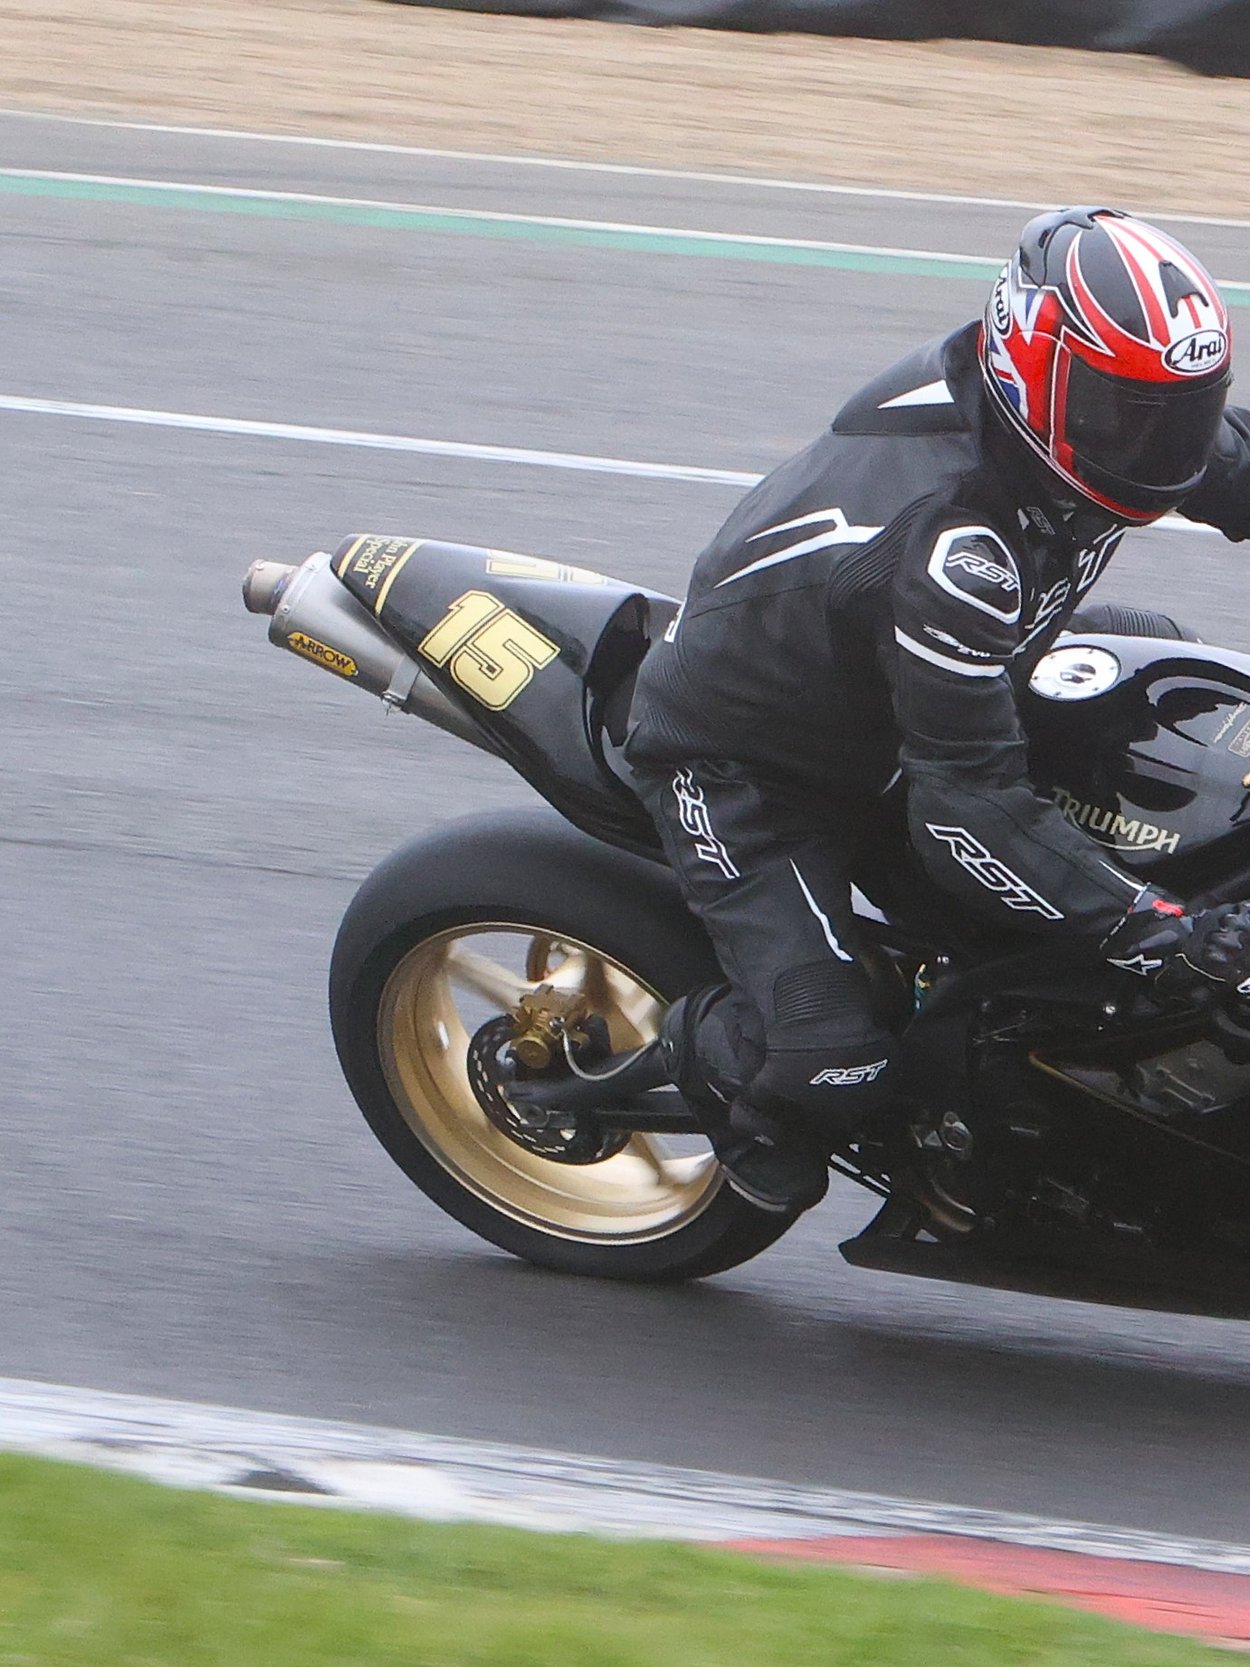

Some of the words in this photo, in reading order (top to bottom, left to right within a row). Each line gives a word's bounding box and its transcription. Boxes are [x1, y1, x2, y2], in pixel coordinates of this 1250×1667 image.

[1171, 332, 1222, 364] Arai
[945, 551, 1020, 592] RST
[294, 635, 351, 668] ARROW
[417, 588, 561, 711] 15
[672, 766, 741, 880] RST
[1051, 785, 1180, 855] TRIUMPH
[925, 822, 1064, 920] RST
[809, 1059, 888, 1086] RST
